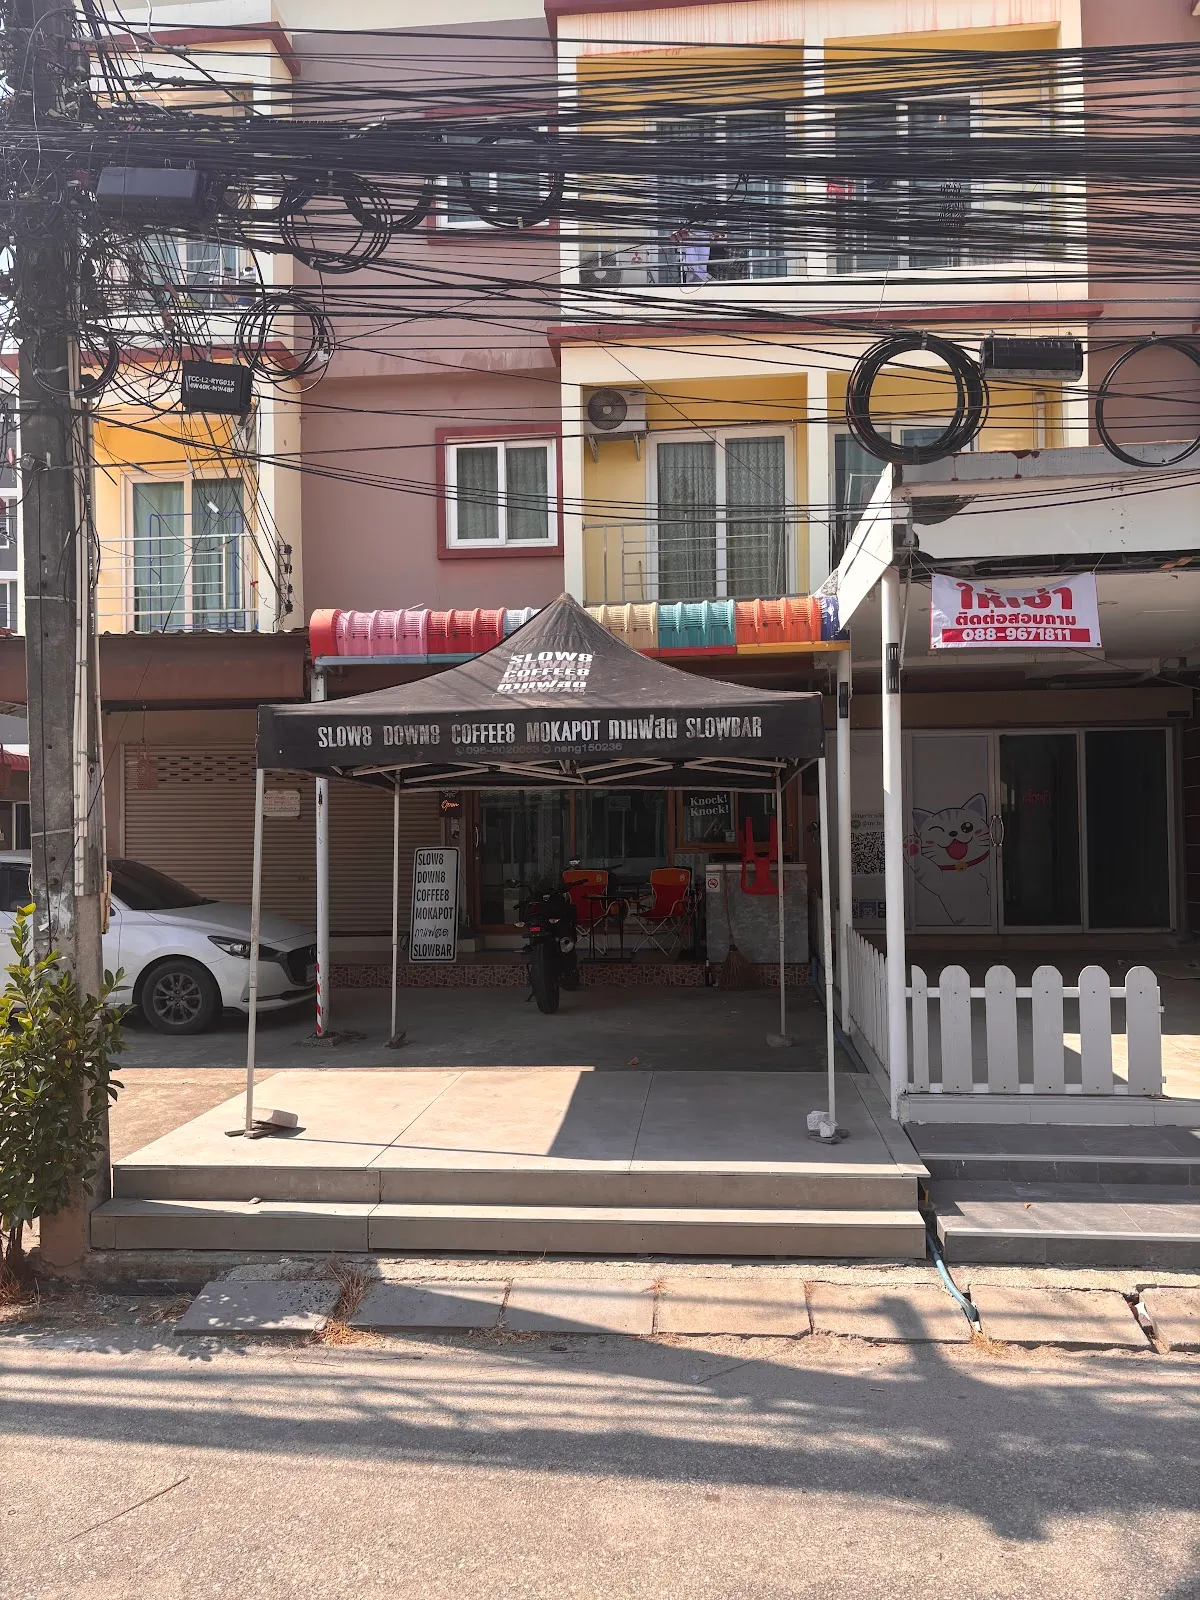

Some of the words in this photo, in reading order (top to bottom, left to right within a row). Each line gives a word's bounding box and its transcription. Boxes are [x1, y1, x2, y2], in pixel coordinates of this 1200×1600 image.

[955, 582, 1073, 610] ให้เช่า
[955, 610, 1077, 626] ติดต่อสอบถาม
[962, 628, 1071, 641] 088-9671811
[508, 651, 593, 664] SLOW8
[503, 668, 590, 678] COFFEE8
[318, 725, 373, 747] SLOW8
[383, 724, 441, 746] DOWN8
[451, 722, 516, 745] COFFEE8
[526, 720, 602, 743] MOKAPOT
[608, 714, 679, 740] กาแฟสด
[685, 716, 763, 739] SLOWBAR
[689, 794, 728, 807] Knock!
[689, 804, 729, 817] Knock!
[417, 853, 444, 865] SLOW8
[417, 871, 446, 883] DOWN8
[416, 889, 450, 901] COFFEE8
[415, 907, 454, 920] MOKAPOT
[413, 944, 452, 957] SLOWBAR
